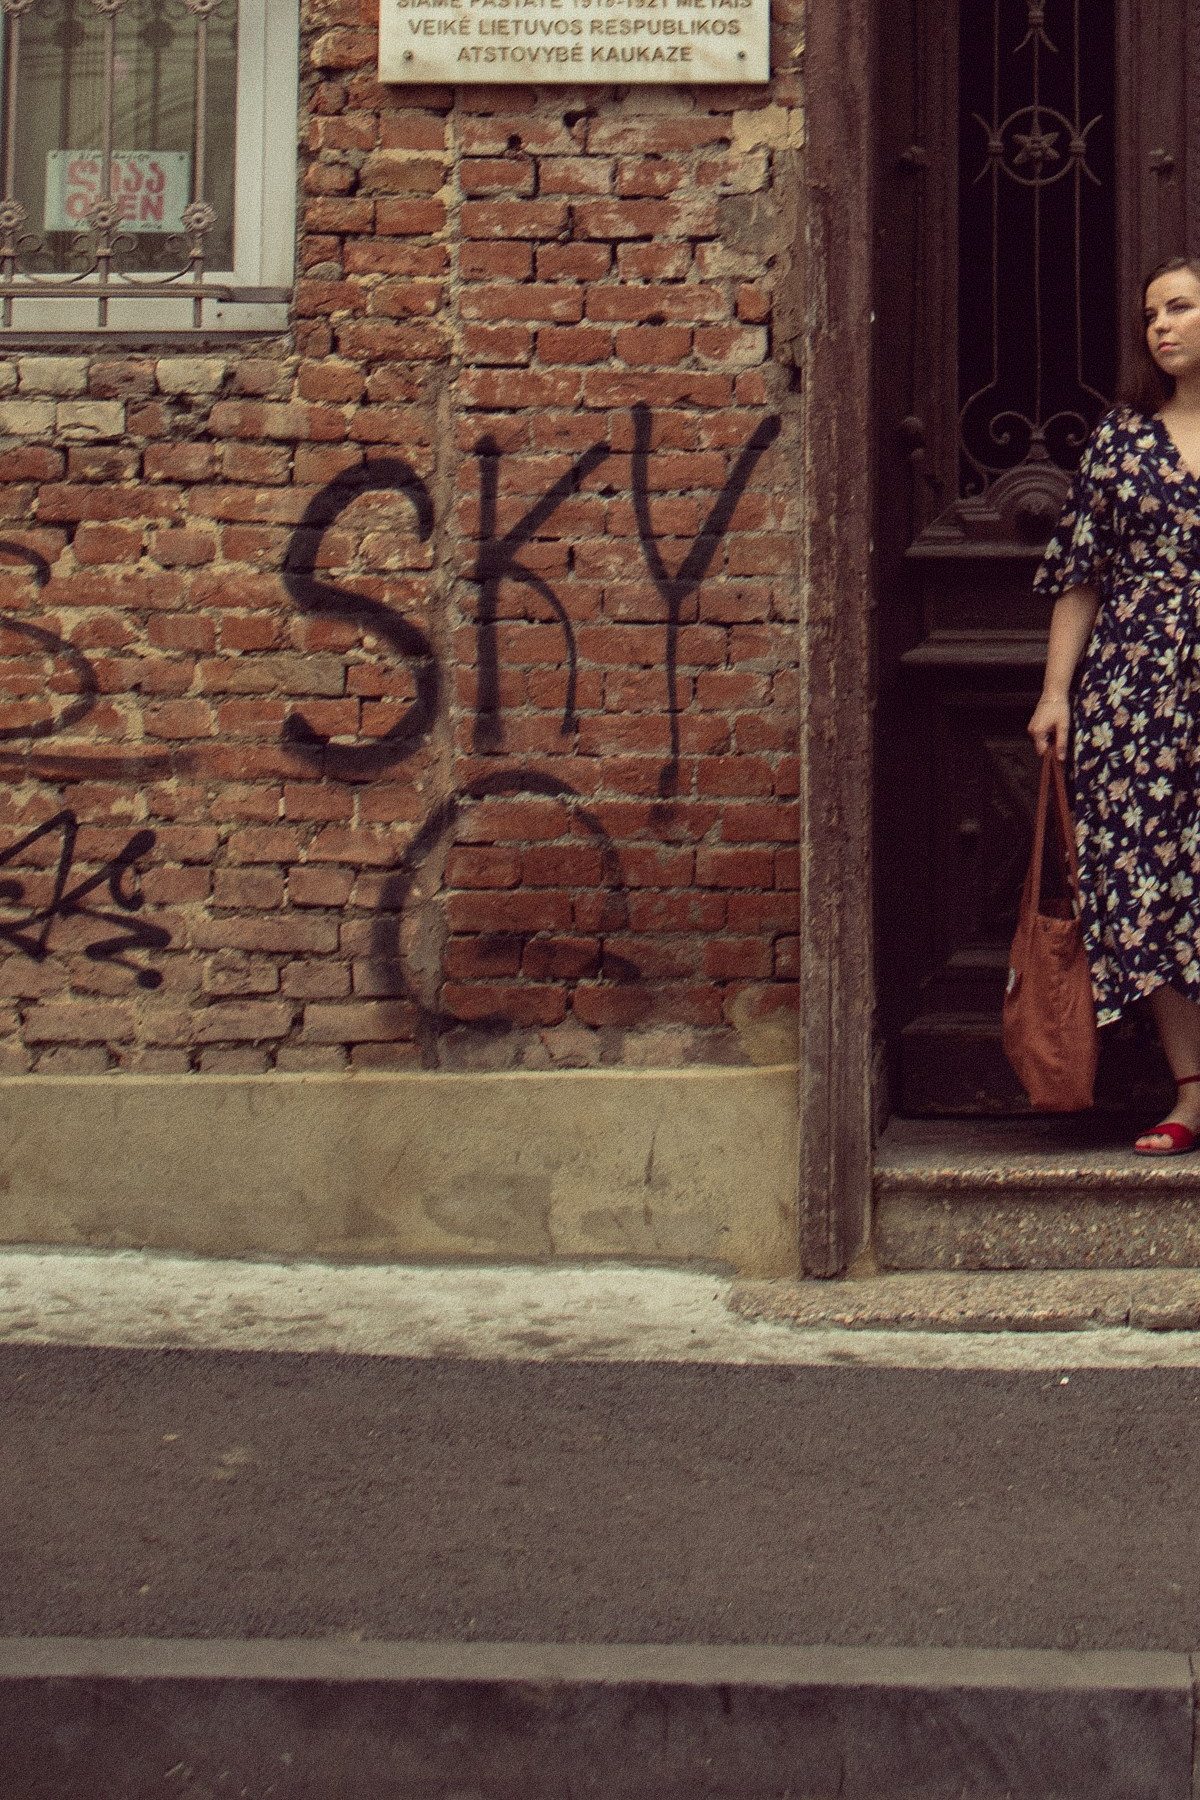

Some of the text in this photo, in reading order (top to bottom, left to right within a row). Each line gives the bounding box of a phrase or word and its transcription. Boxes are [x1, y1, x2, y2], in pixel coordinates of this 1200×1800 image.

[478, 18, 584, 36] LIETUVOS
[590, 18, 742, 36] RESPUBLIKOS
[590, 46, 694, 63] KAUKAZE
[66, 193, 165, 221] OEN
[282, 402, 782, 808] SKY
